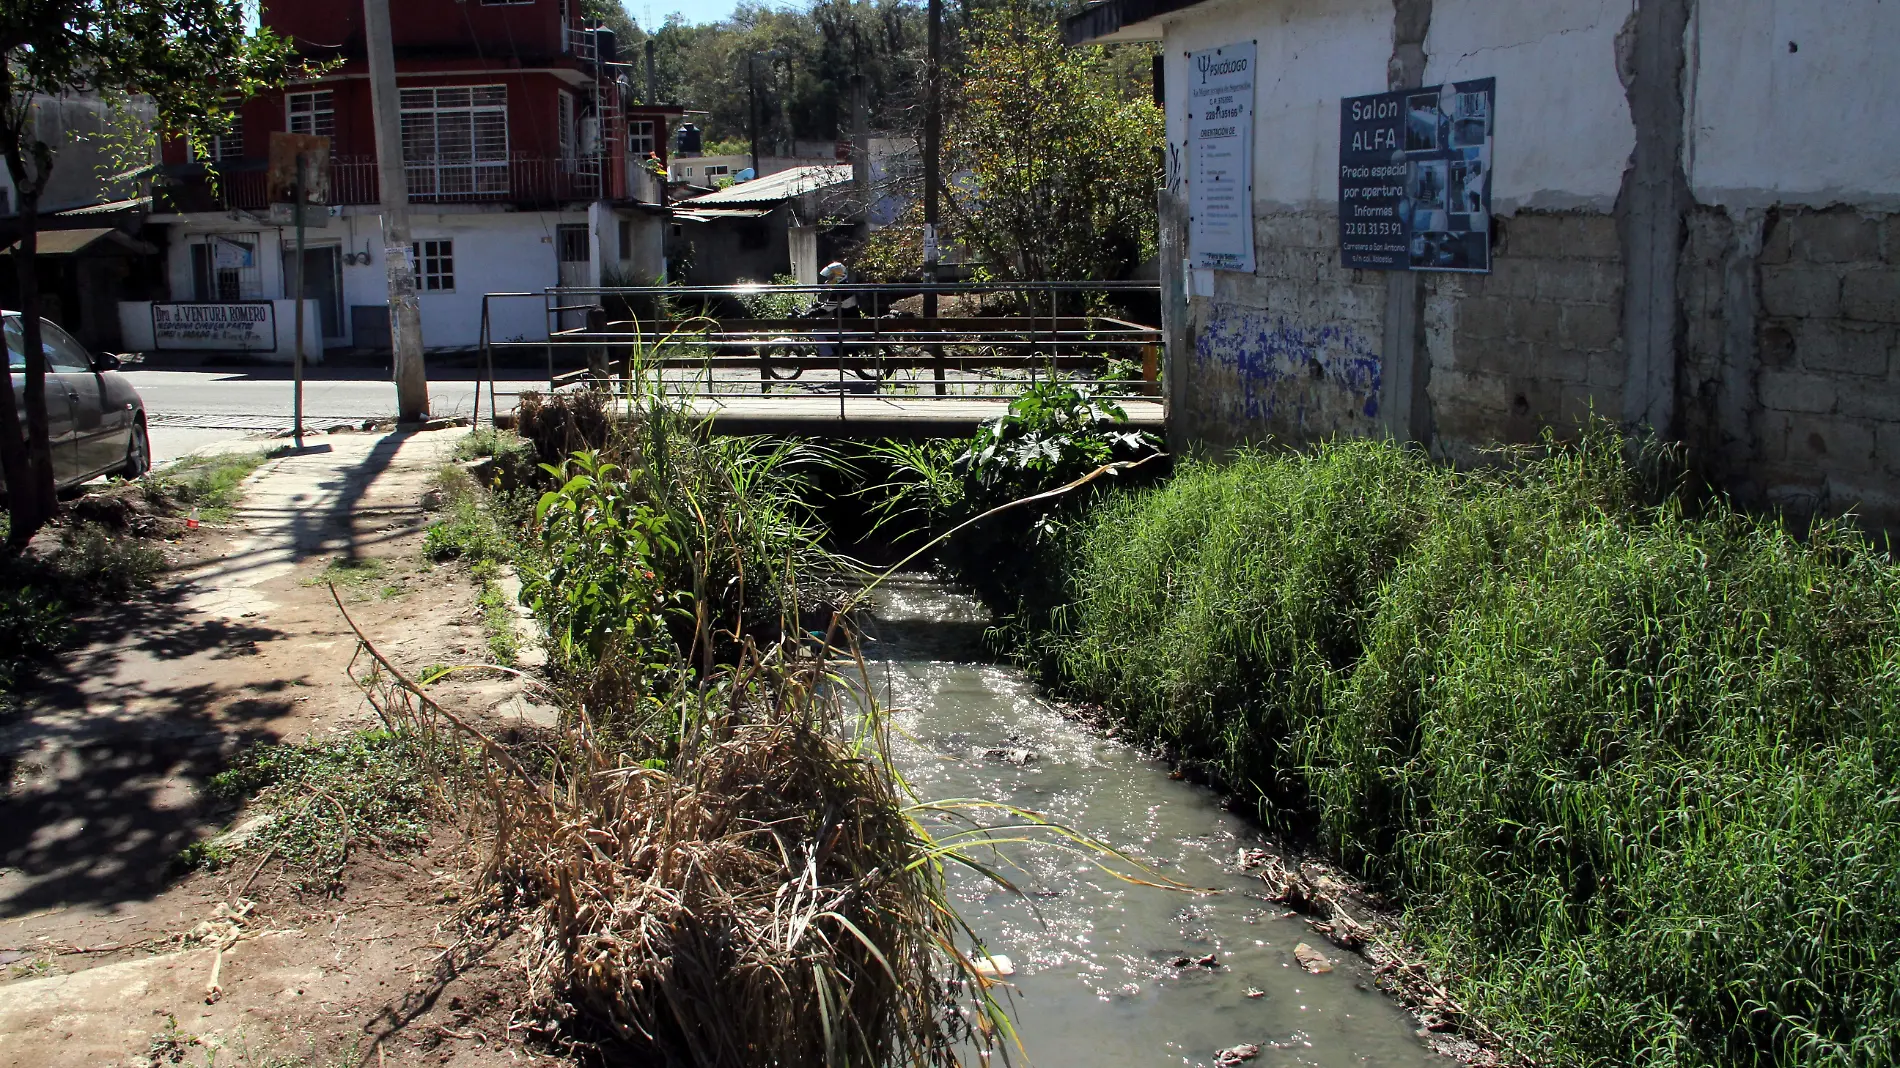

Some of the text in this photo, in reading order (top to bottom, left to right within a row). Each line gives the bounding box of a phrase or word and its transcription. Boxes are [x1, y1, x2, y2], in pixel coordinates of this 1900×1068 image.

[1352, 128, 1396, 151] ALFA
[1342, 162, 1407, 179] Precio especial
[1344, 185, 1403, 201] por apertura
[1354, 205, 1393, 217] Informes
[1345, 222, 1402, 235] 22 81 31 53 91
[1343, 242, 1368, 251] Carretera
[1373, 243, 1383, 251] San
[1384, 243, 1406, 252] Antonio
[182, 306, 227, 322] VENTURA
[229, 306, 266, 322] ROMERO
[157, 322, 193, 330] MEDICINA
